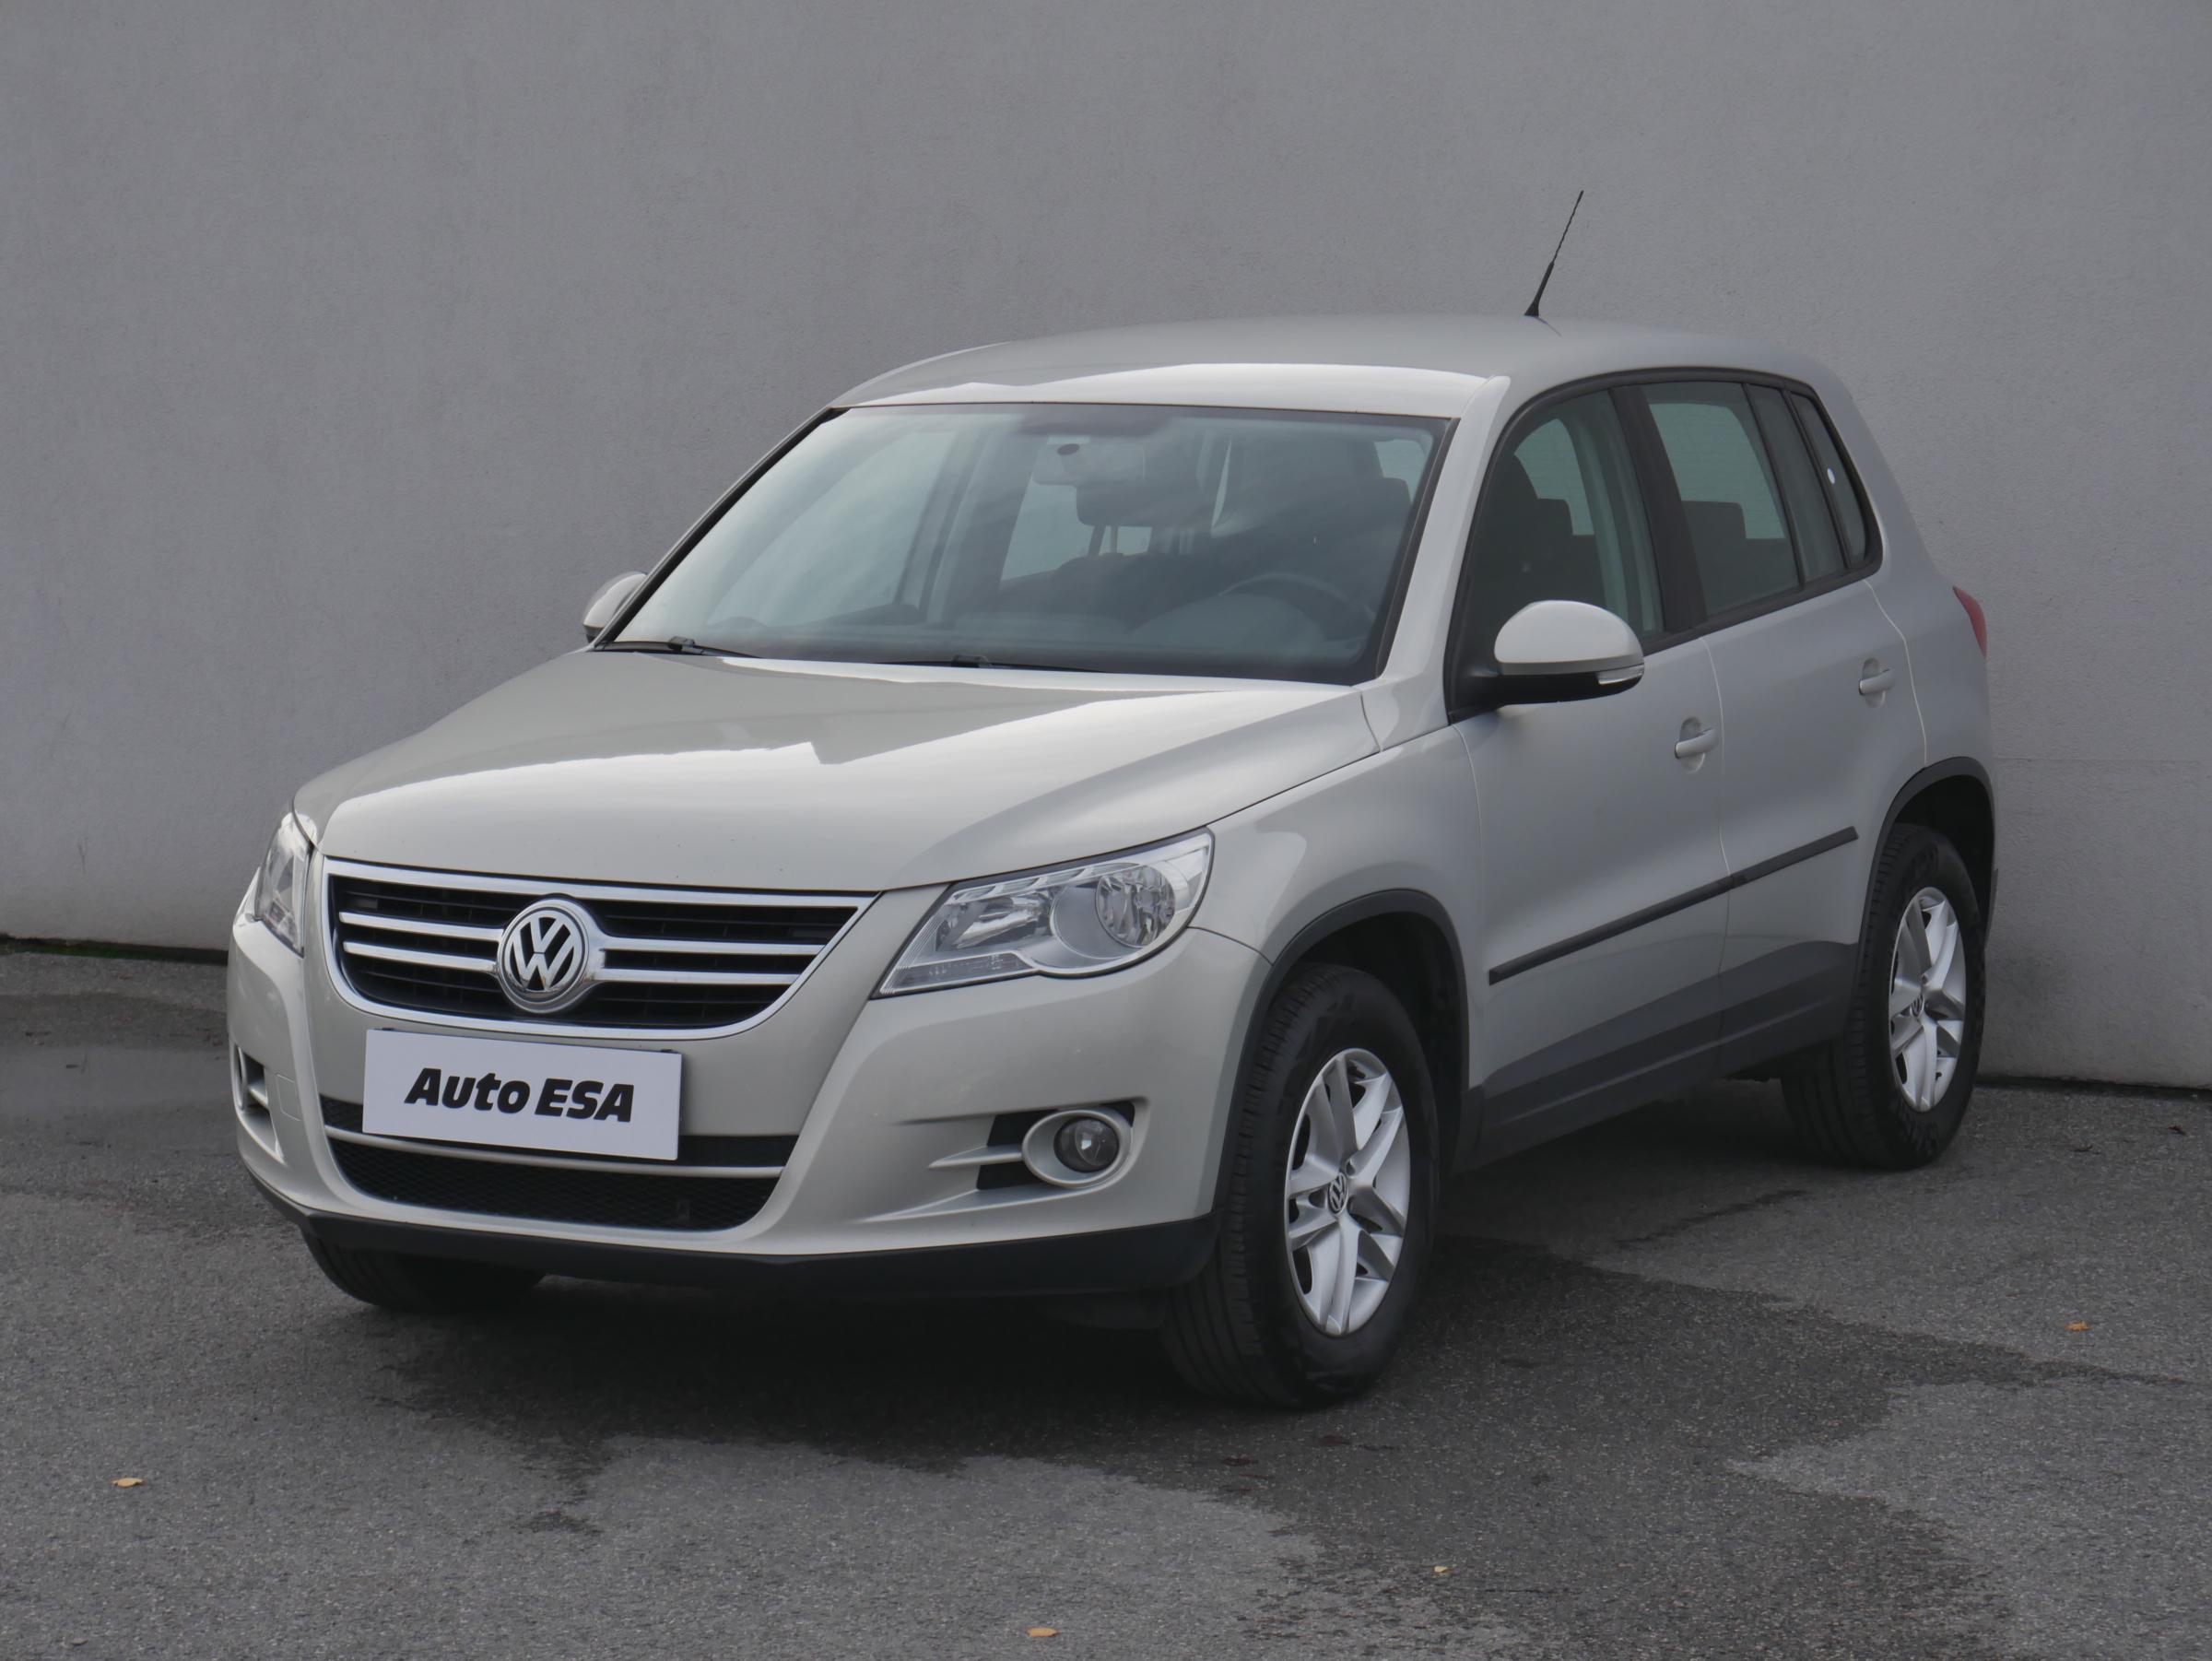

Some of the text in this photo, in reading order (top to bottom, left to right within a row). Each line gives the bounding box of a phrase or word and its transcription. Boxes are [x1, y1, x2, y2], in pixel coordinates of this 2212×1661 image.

[506, 911, 582, 994] VW
[405, 1067, 635, 1123] Auto ESA
